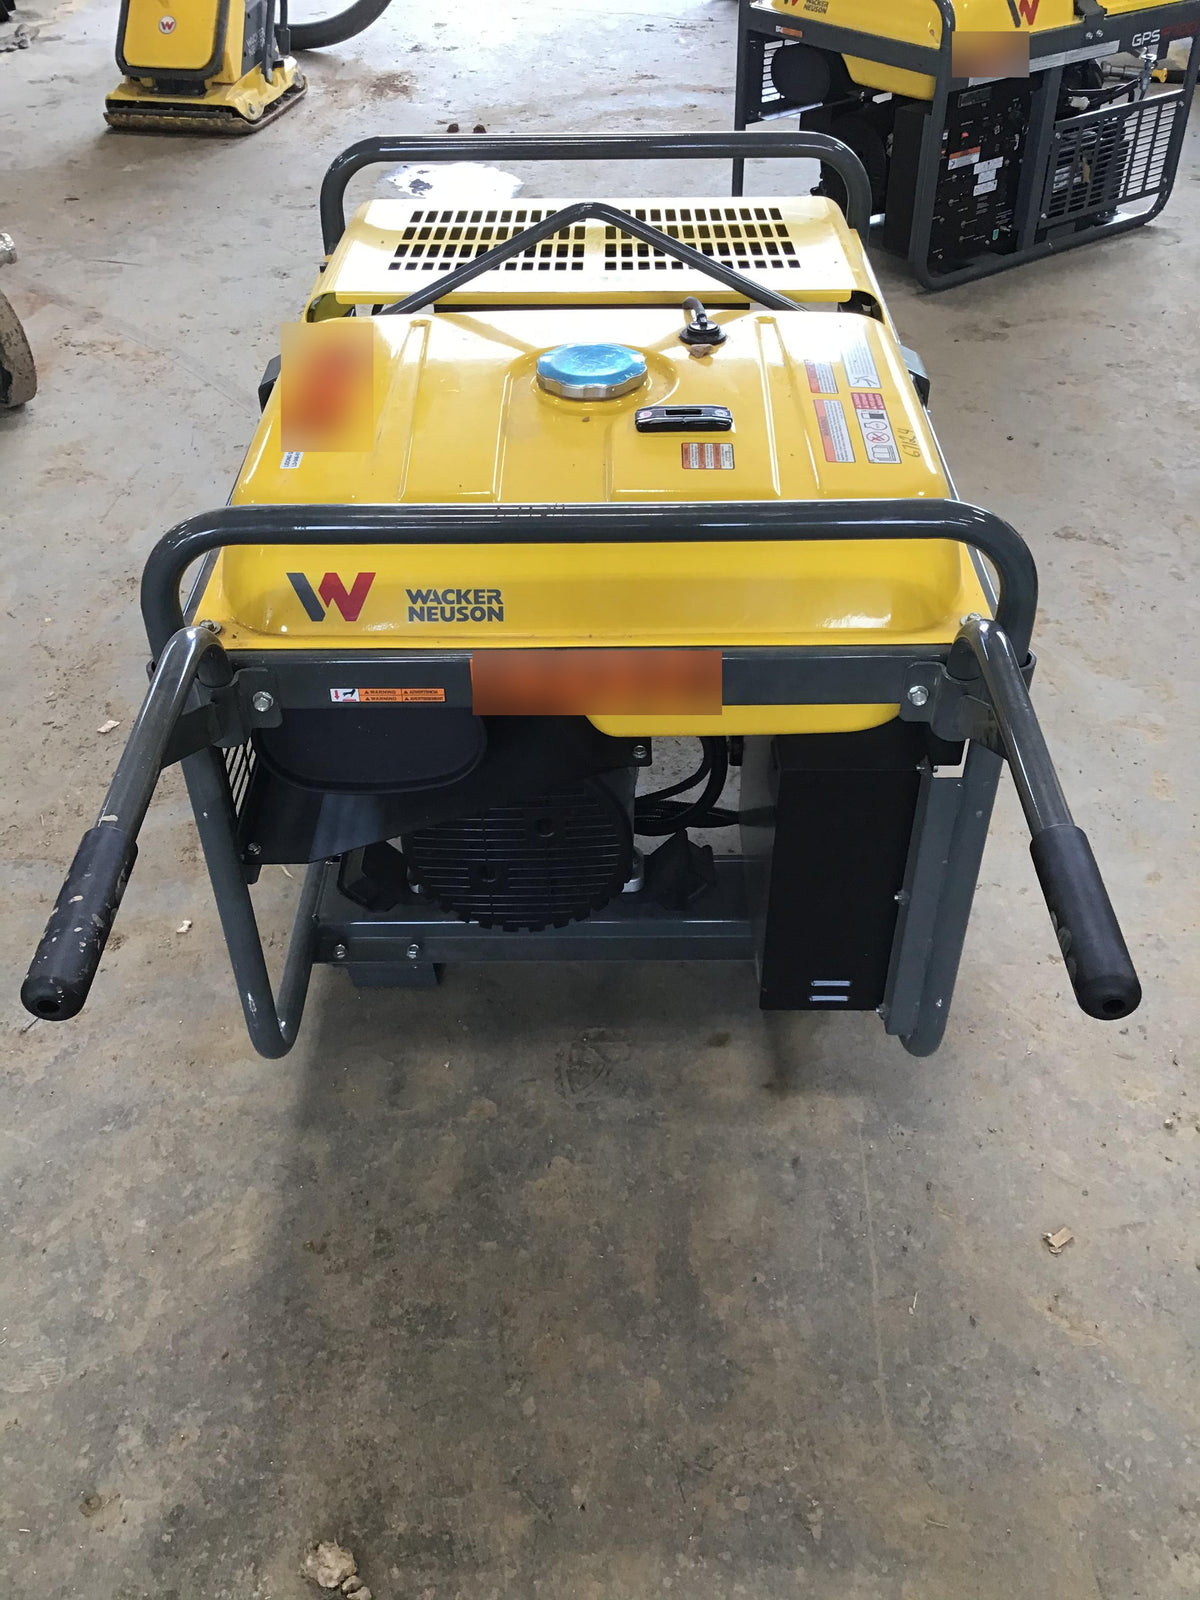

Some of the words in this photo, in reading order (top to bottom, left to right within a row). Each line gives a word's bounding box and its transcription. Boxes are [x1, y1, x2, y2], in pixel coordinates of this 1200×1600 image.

[1131, 29, 1161, 47] GPS
[405, 589, 504, 605] WACKER
[408, 606, 504, 622] NEUSON
